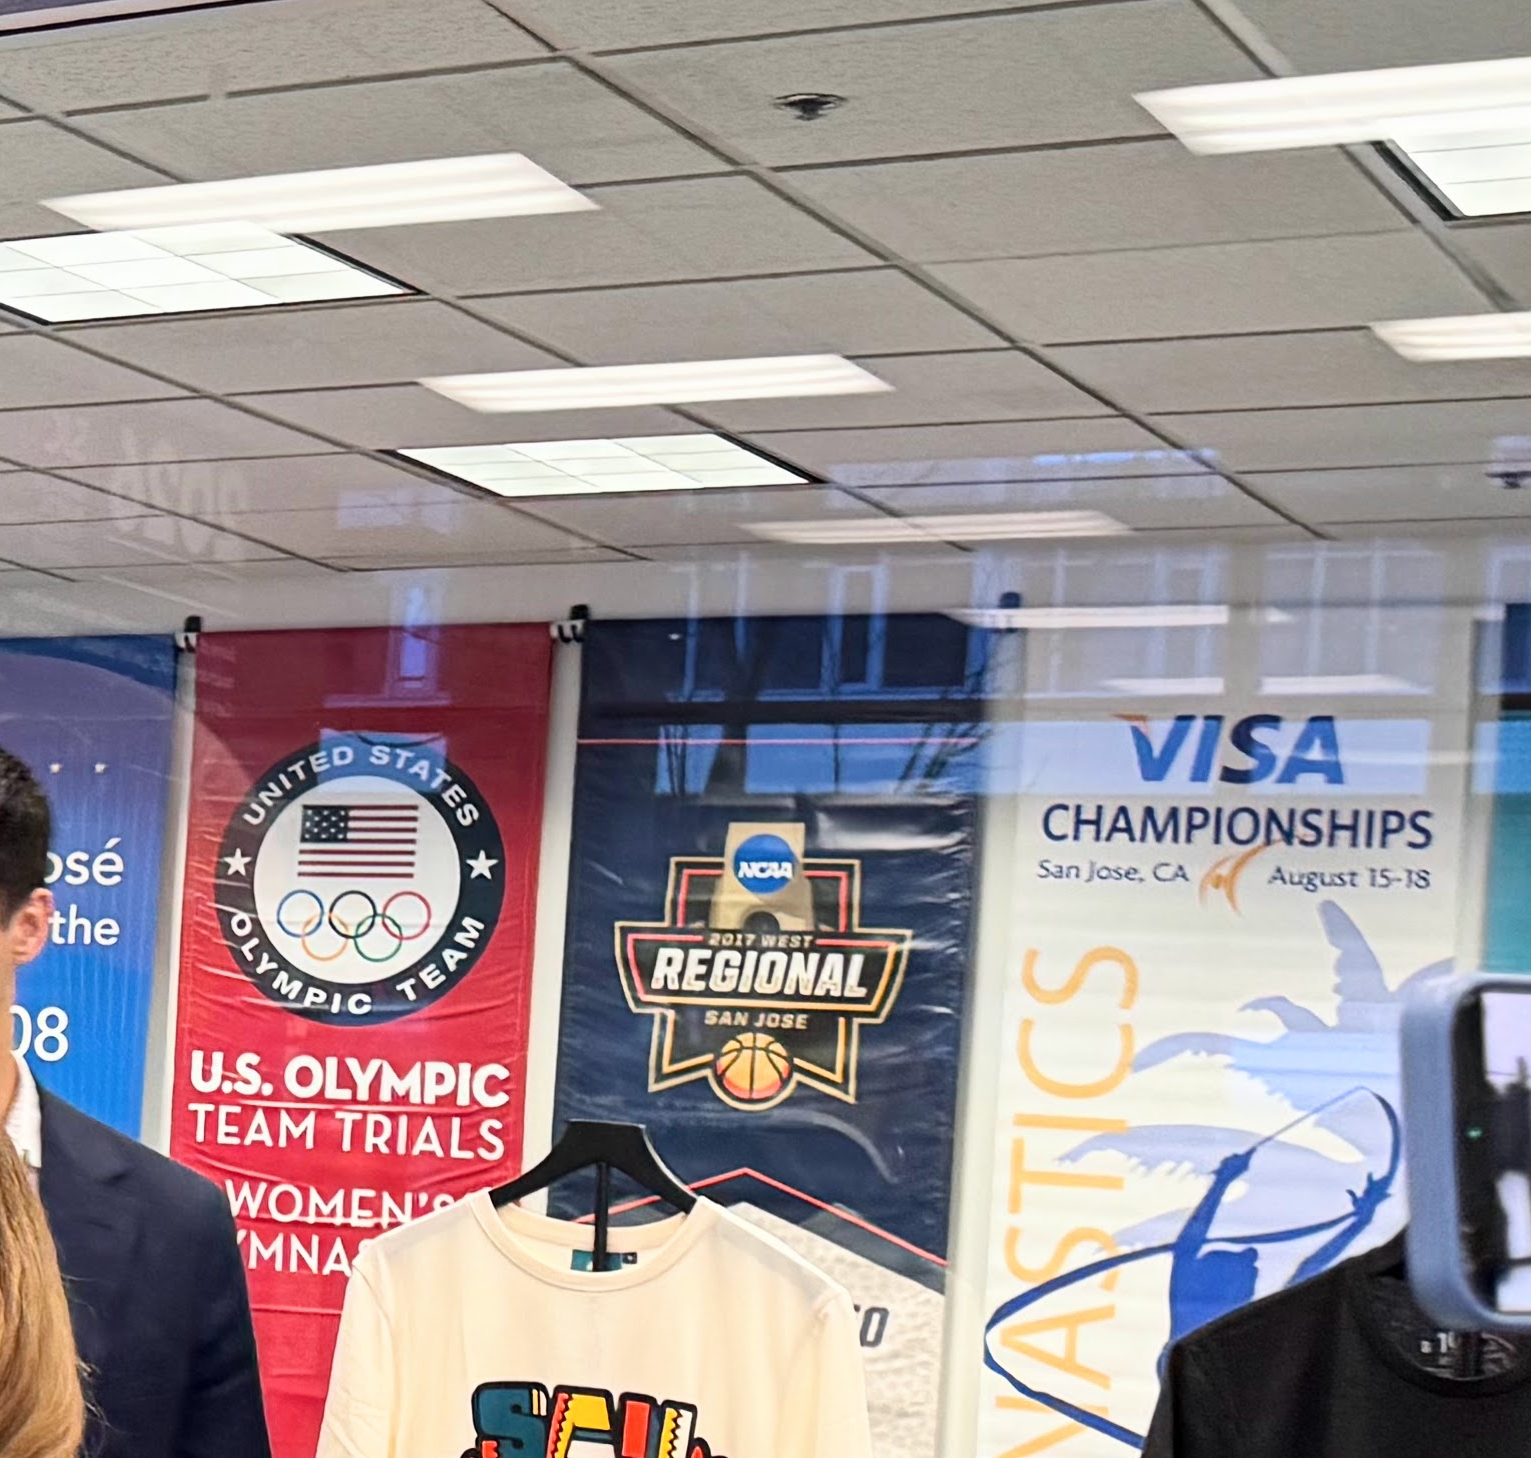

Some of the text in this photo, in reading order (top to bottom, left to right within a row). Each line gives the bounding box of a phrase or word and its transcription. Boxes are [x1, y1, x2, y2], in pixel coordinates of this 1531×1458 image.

[1115, 714, 1346, 785] VISA
[241, 745, 355, 826] UNITED
[368, 744, 481, 828] STATES
[1041, 802, 1434, 850] CHAMPIONSHIPS
[737, 859, 794, 881] NCAA
[1038, 860, 1190, 885] San Jose, CA
[1268, 866, 1432, 892] August 15-18
[48, 903, 121, 946] the
[708, 932, 814, 949] 2017 WEST
[230, 911, 486, 1015] OLYMPIC TEAM
[650, 947, 869, 998] REGIONAL
[704, 1010, 809, 1031] SAN JOSE
[188, 1049, 511, 1109] U.S. OLYMPIC
[187, 1102, 506, 1162] TEAM TRIALS
